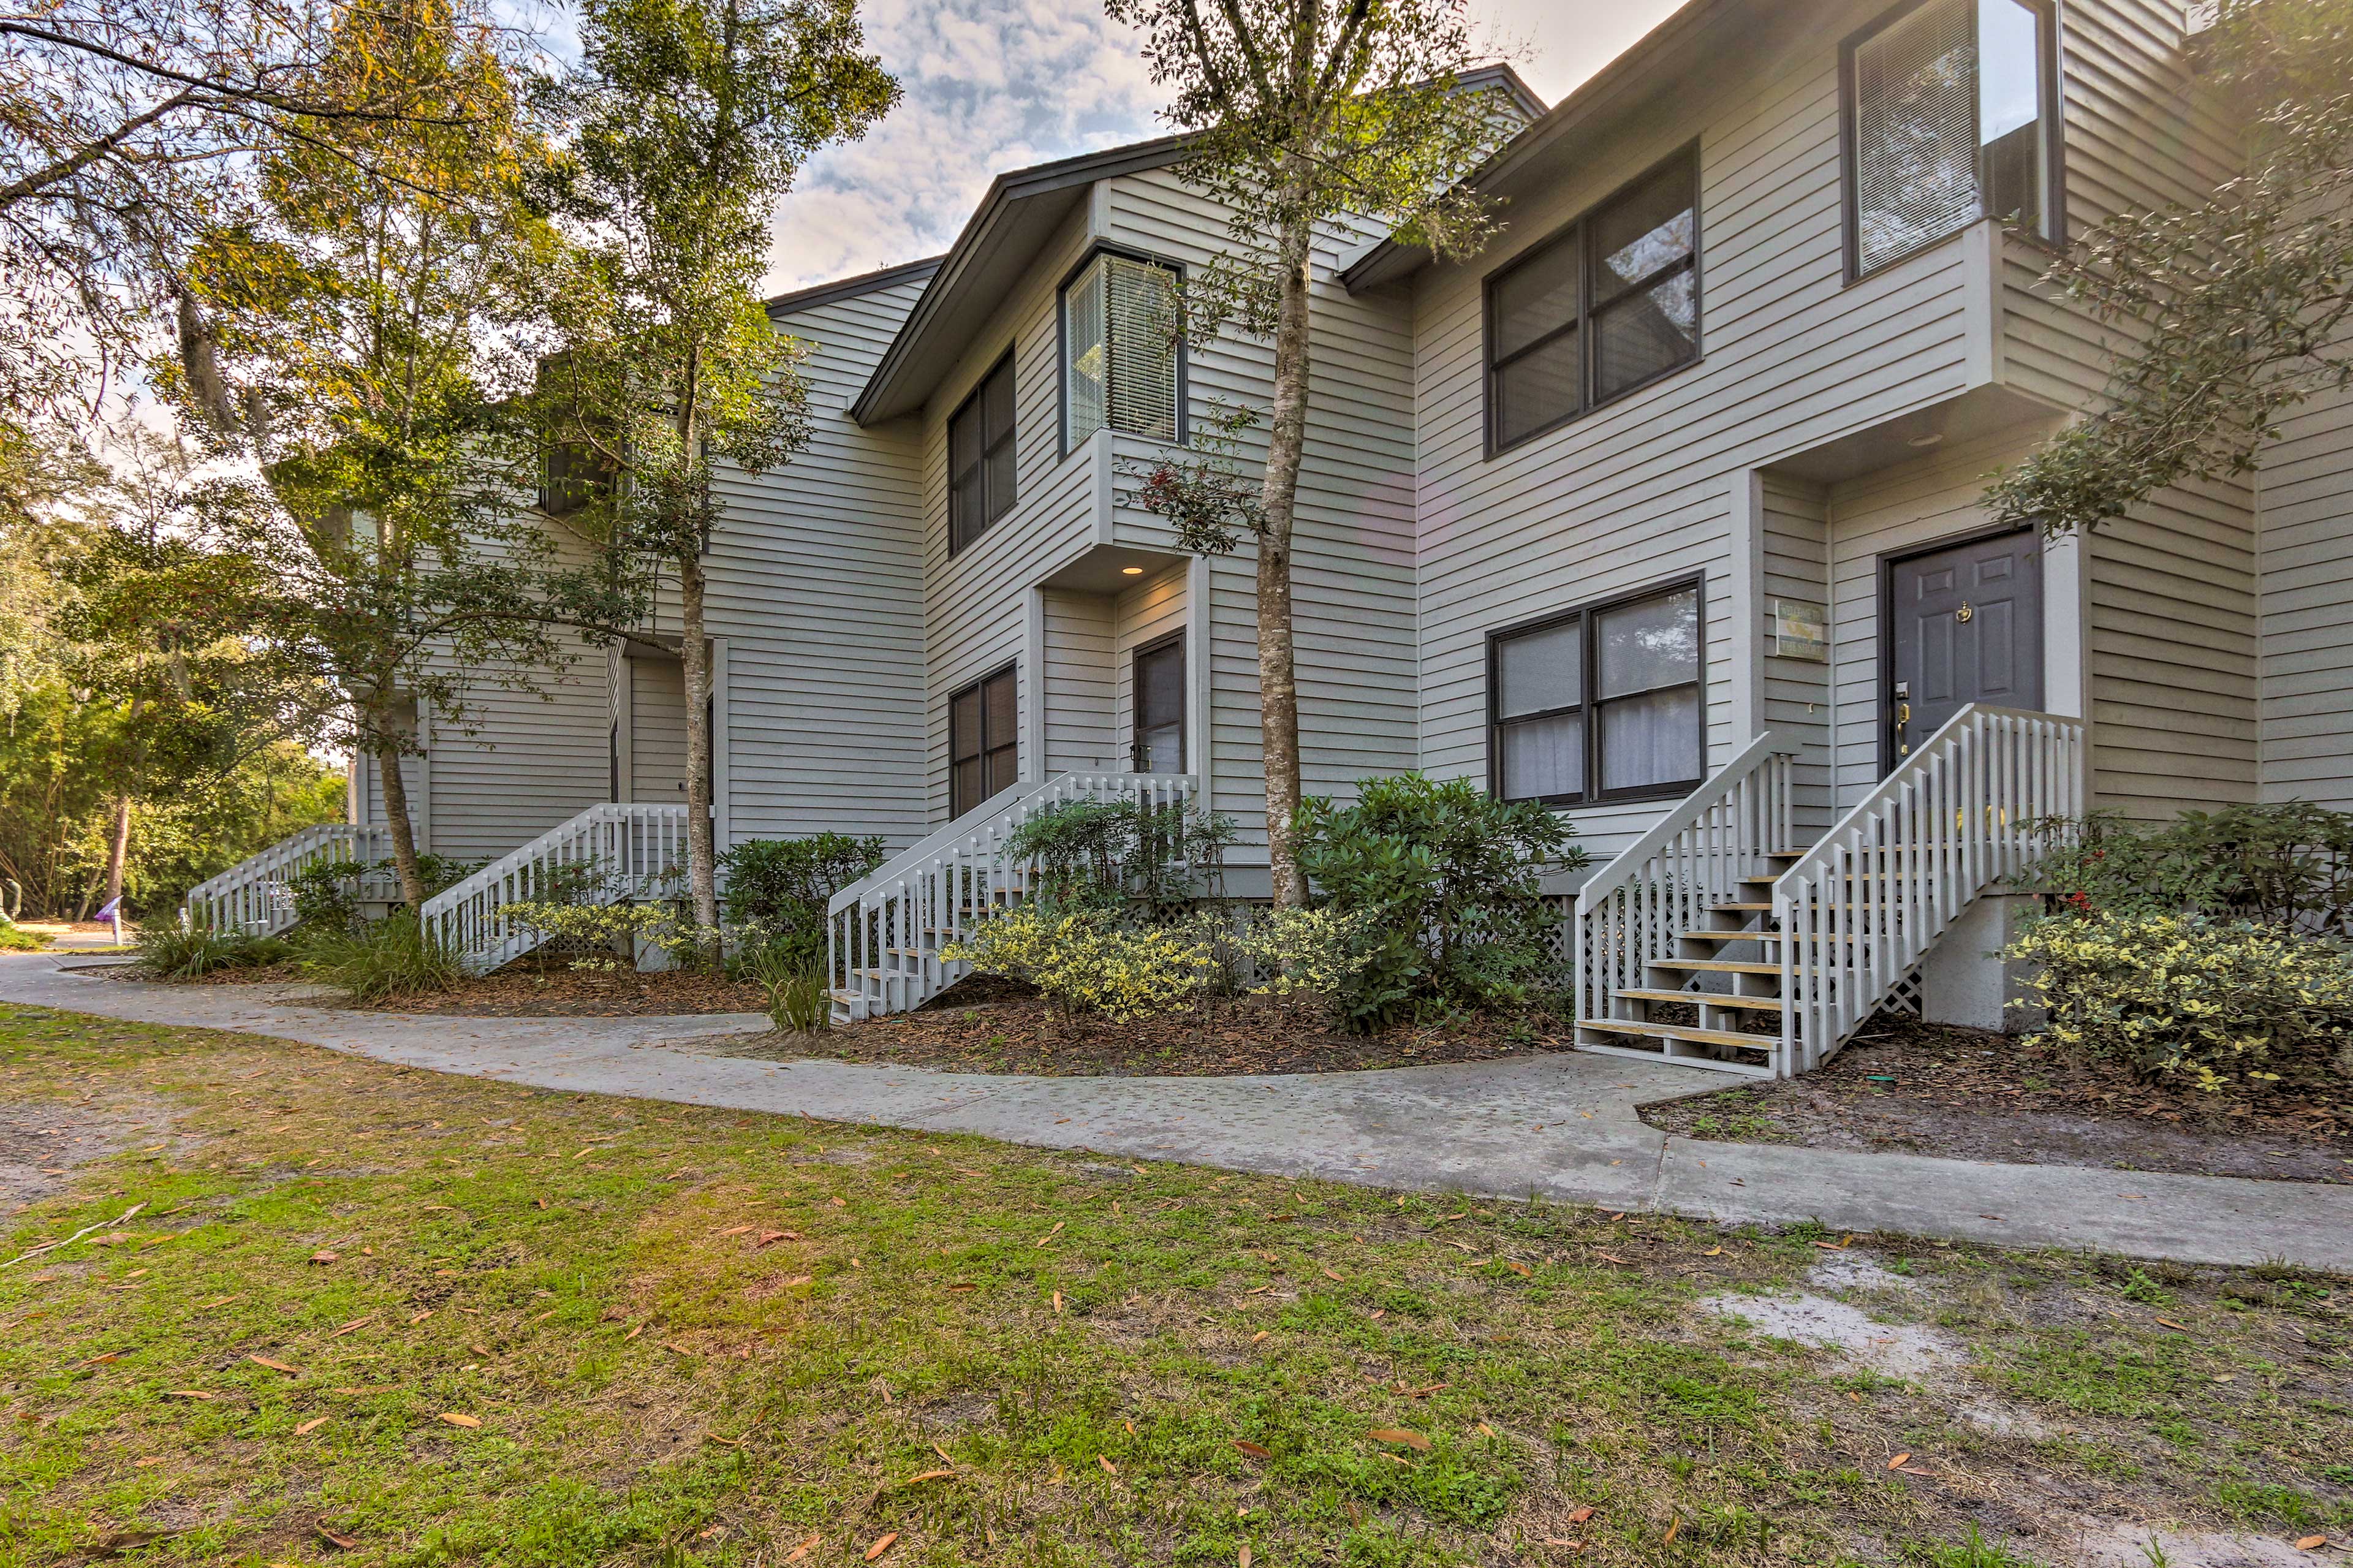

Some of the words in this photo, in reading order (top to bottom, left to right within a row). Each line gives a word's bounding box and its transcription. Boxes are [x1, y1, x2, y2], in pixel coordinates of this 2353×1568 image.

[1779, 605, 1811, 619] WELCOME
[1811, 609, 1821, 620] TO
[1781, 640, 1797, 652] THE
